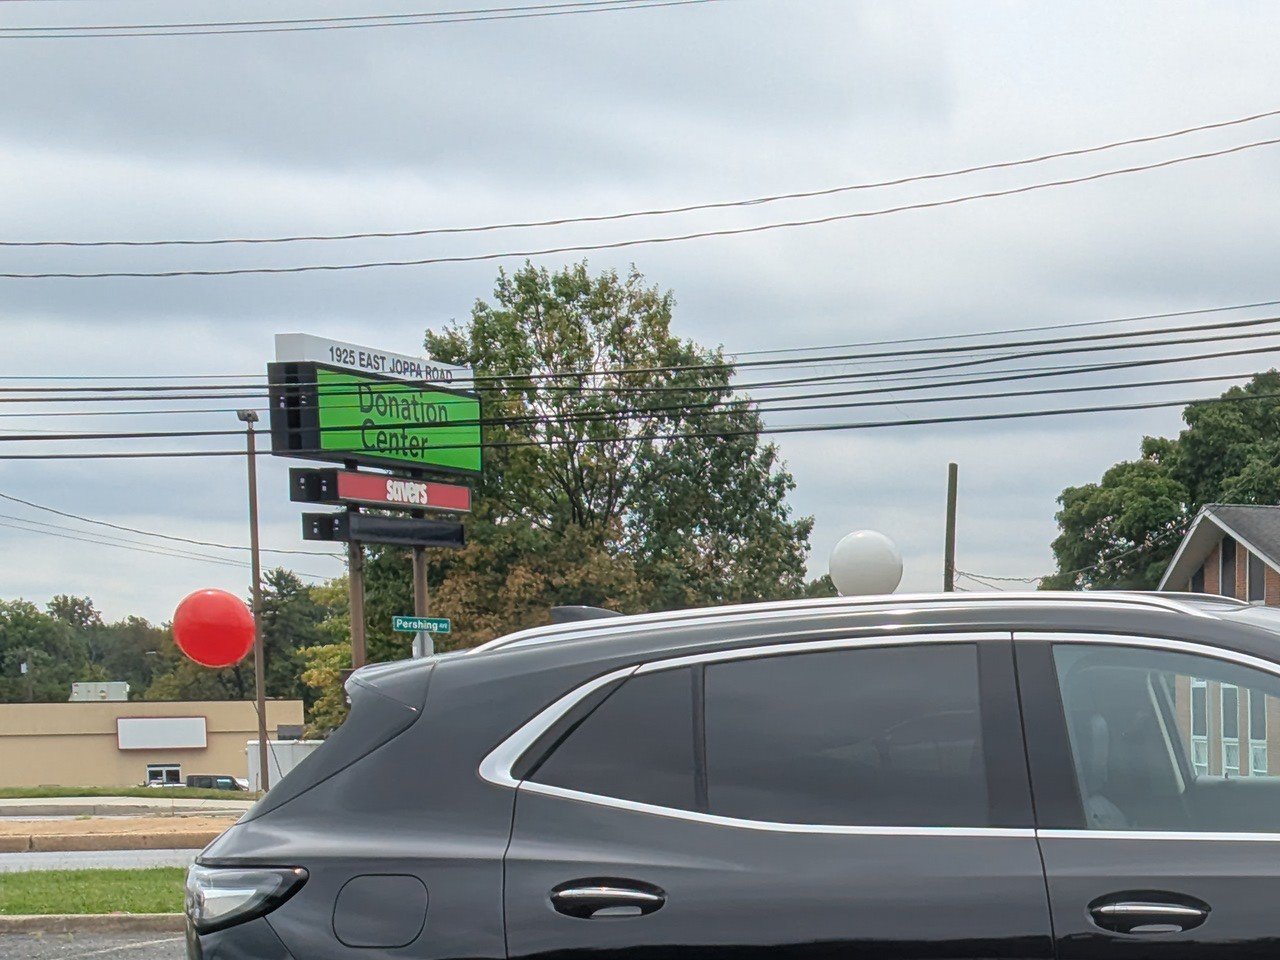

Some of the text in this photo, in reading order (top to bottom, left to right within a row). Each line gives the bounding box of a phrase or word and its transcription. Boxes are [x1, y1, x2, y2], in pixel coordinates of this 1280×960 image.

[329, 346, 453, 383] 1925 EAST JOPPA ROAD
[358, 384, 448, 423] Donation
[361, 418, 429, 459] Center
[396, 618, 438, 631] Pershing
